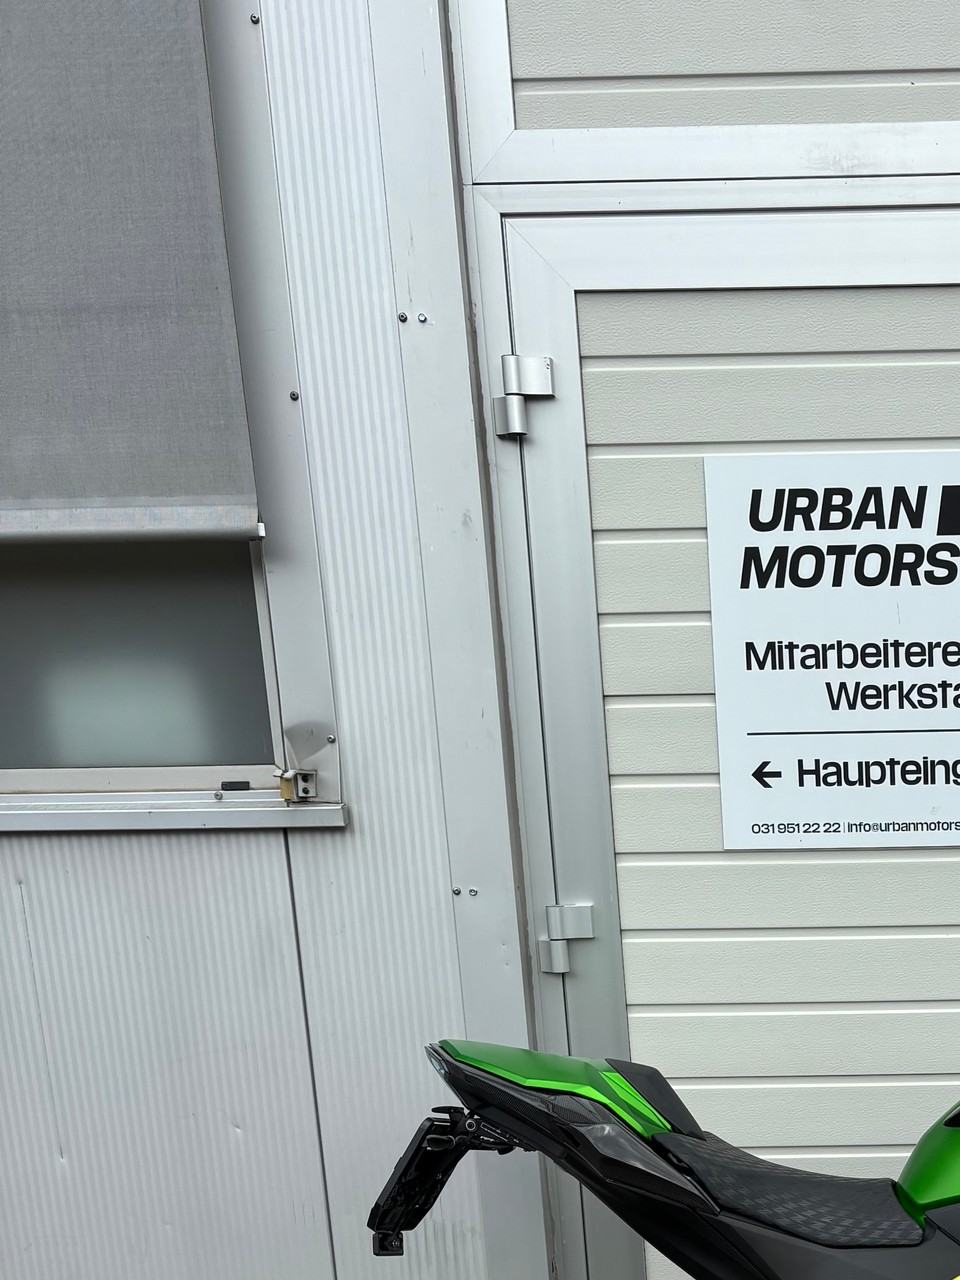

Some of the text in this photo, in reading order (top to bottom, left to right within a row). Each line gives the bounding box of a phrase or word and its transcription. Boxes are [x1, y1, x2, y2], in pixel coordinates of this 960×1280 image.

[749, 485, 928, 532] URBAN
[739, 543, 960, 589] MOTORS
[751, 823, 775, 834] 031
[777, 823, 801, 834] 951
[802, 822, 821, 834] 22
[823, 822, 841, 834] 22
